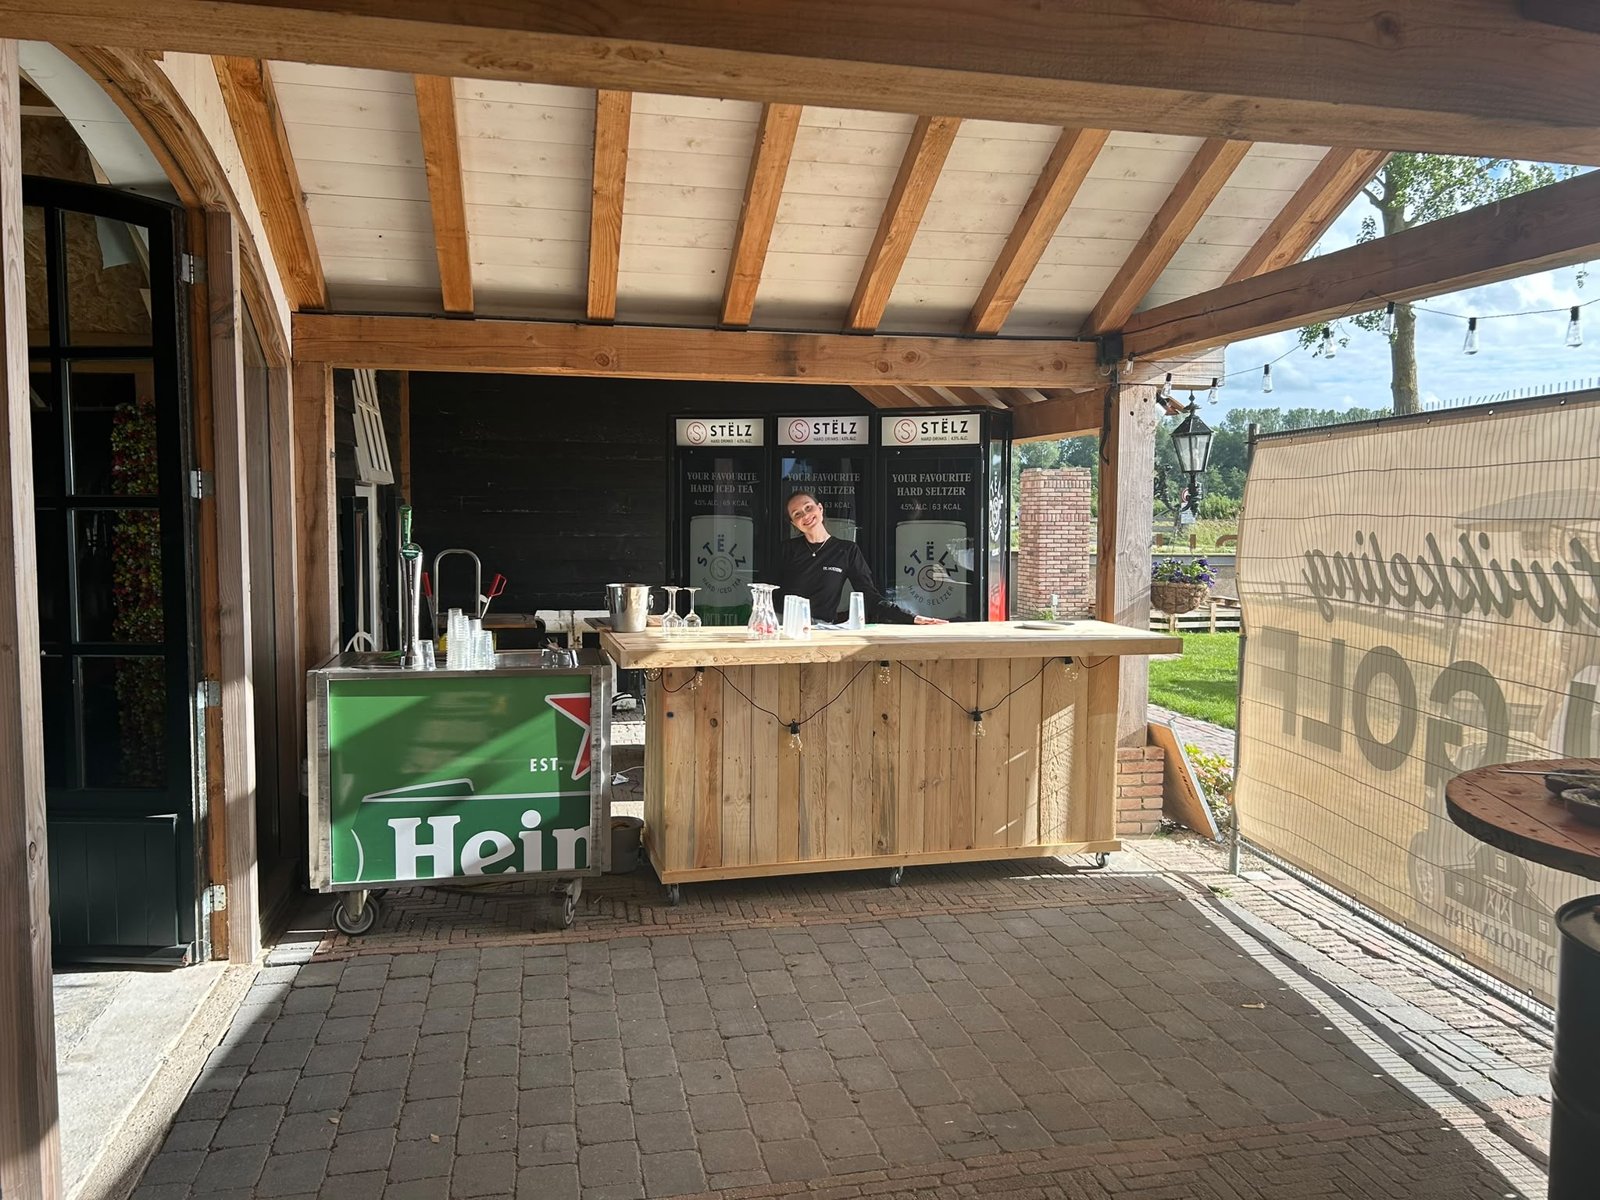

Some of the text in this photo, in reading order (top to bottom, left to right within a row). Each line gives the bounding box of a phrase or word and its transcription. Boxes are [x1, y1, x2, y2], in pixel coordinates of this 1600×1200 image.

[710, 422, 752, 437] STËLZ
[813, 420, 857, 434] STËLZ
[921, 418, 968, 434] STËLZ
[687, 472, 757, 481] YOUR FAVOURITE
[788, 472, 860, 482] YOUR FAVOURITE
[892, 473, 971, 482] YOUR FAVOURITE
[690, 484, 754, 494] HARD ICED TEA
[818, 486, 856, 494] SELTZER
[897, 487, 966, 496] HARD SELTZER
[904, 541, 959, 577] STËLZ
[530, 757, 563, 772] EST.
